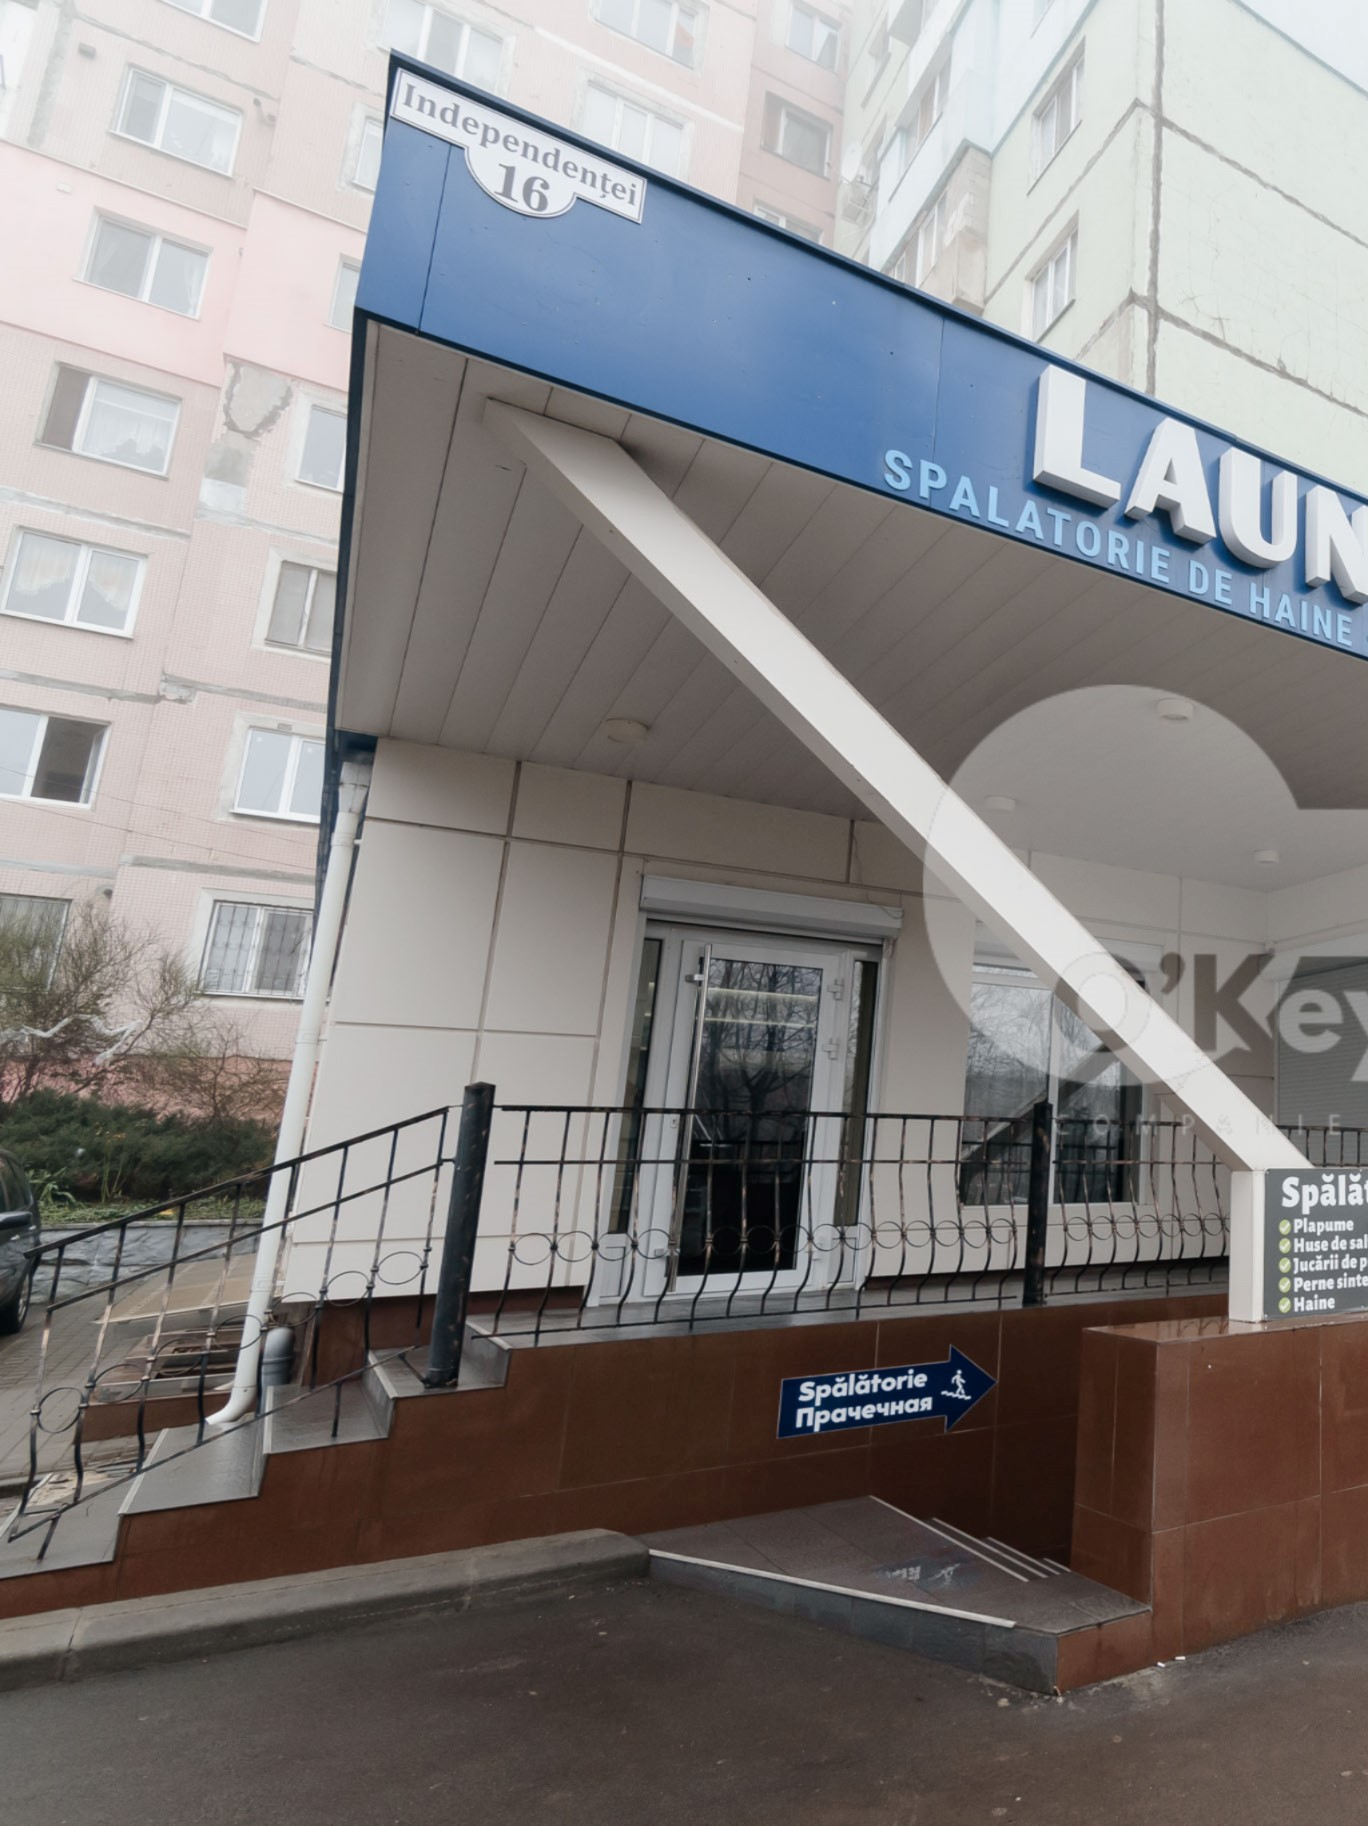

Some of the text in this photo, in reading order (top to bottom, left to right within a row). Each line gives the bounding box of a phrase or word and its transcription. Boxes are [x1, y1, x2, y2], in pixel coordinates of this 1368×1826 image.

[402, 82, 638, 208] Independenței
[494, 162, 550, 214] 16
[883, 448, 1352, 647] SPALATORIE DE HAINE
[1293, 1217, 1354, 1236] Plapume
[1293, 1237, 1328, 1253] Huse
[1331, 1235, 1347, 1251] de
[1293, 1253, 1339, 1274] Jucării
[1341, 1253, 1357, 1269] de
[1293, 1277, 1334, 1292] Perne
[1293, 1294, 1335, 1312] Haine
[798, 1368, 928, 1406] Spălătorie
[795, 1396, 933, 1432] Прачечная
